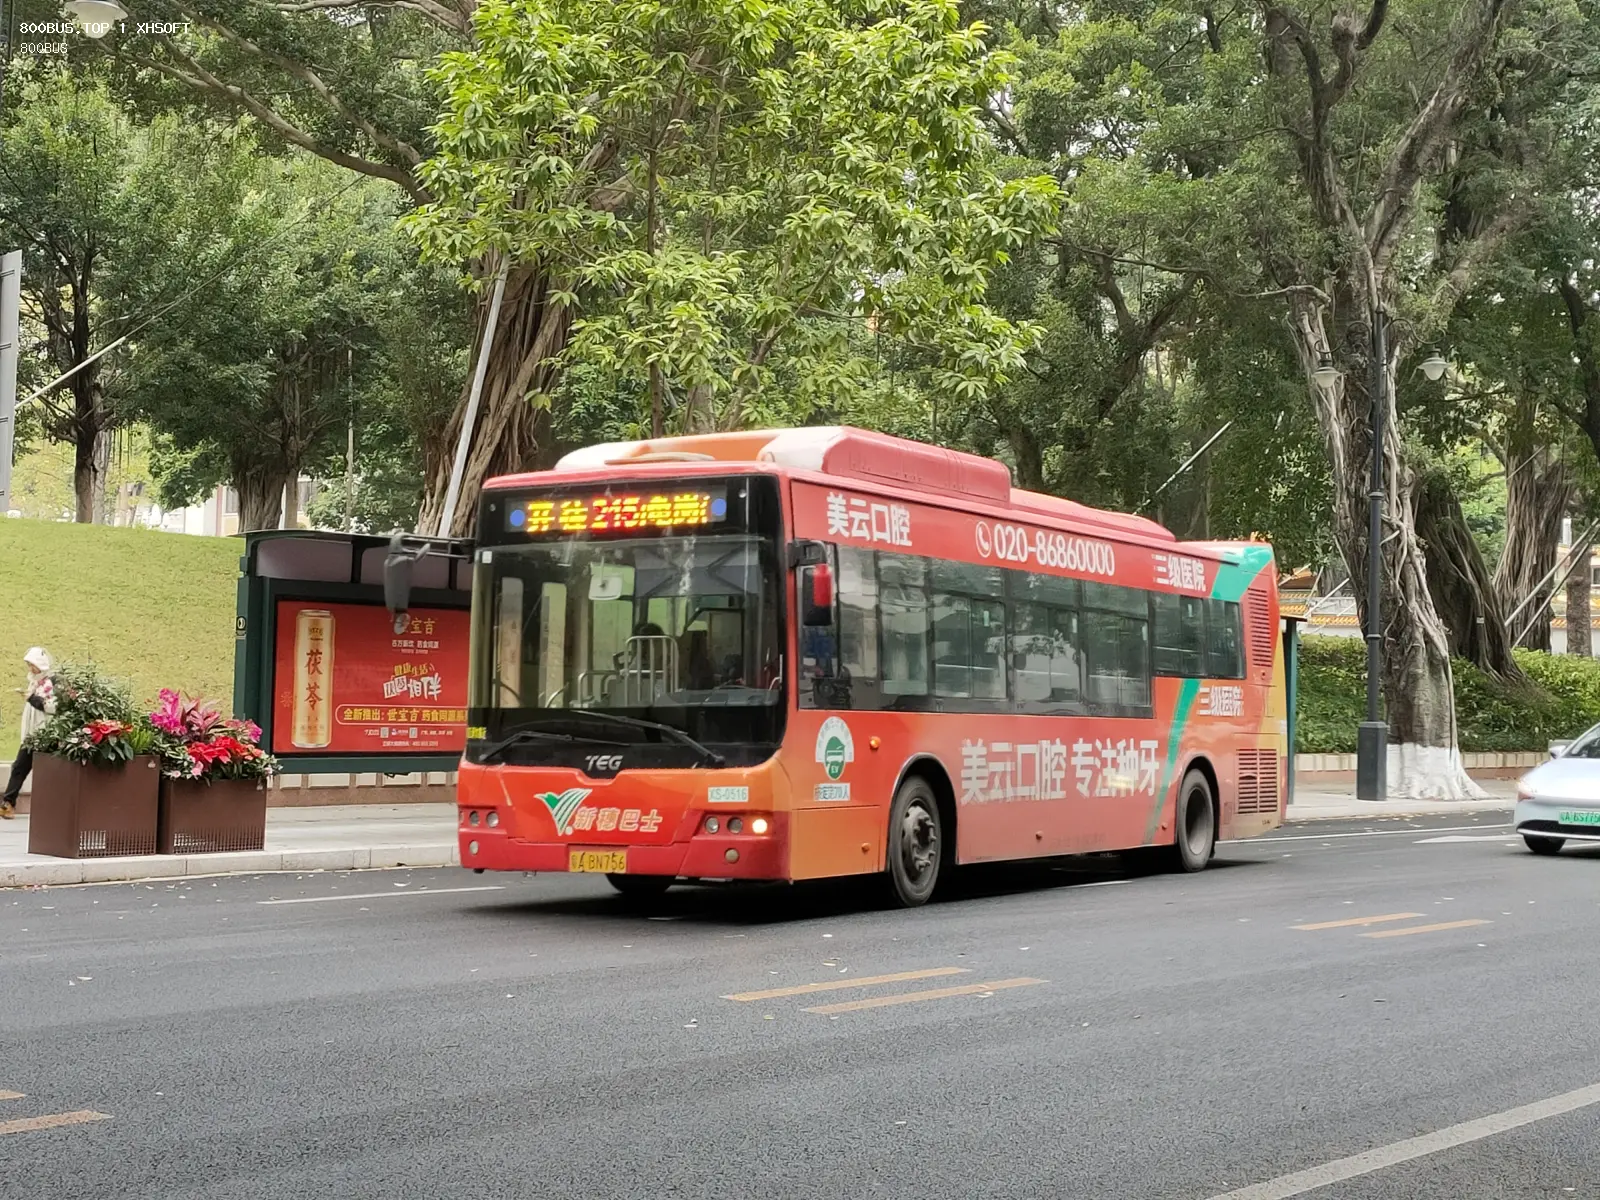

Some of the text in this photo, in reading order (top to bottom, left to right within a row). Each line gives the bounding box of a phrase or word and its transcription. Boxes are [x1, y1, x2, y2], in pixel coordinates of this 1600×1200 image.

[826, 493, 912, 548] 美云口腔
[993, 524, 1116, 577] 020-86860000
[1151, 553, 1207, 593] 三级医院
[304, 649, 323, 711] 茯苓
[1197, 685, 1244, 717] 三级医院
[585, 755, 624, 771] TEG
[960, 737, 1161, 805] 美云口腔 专注种牙
[574, 806, 663, 833] 新穗巴士
